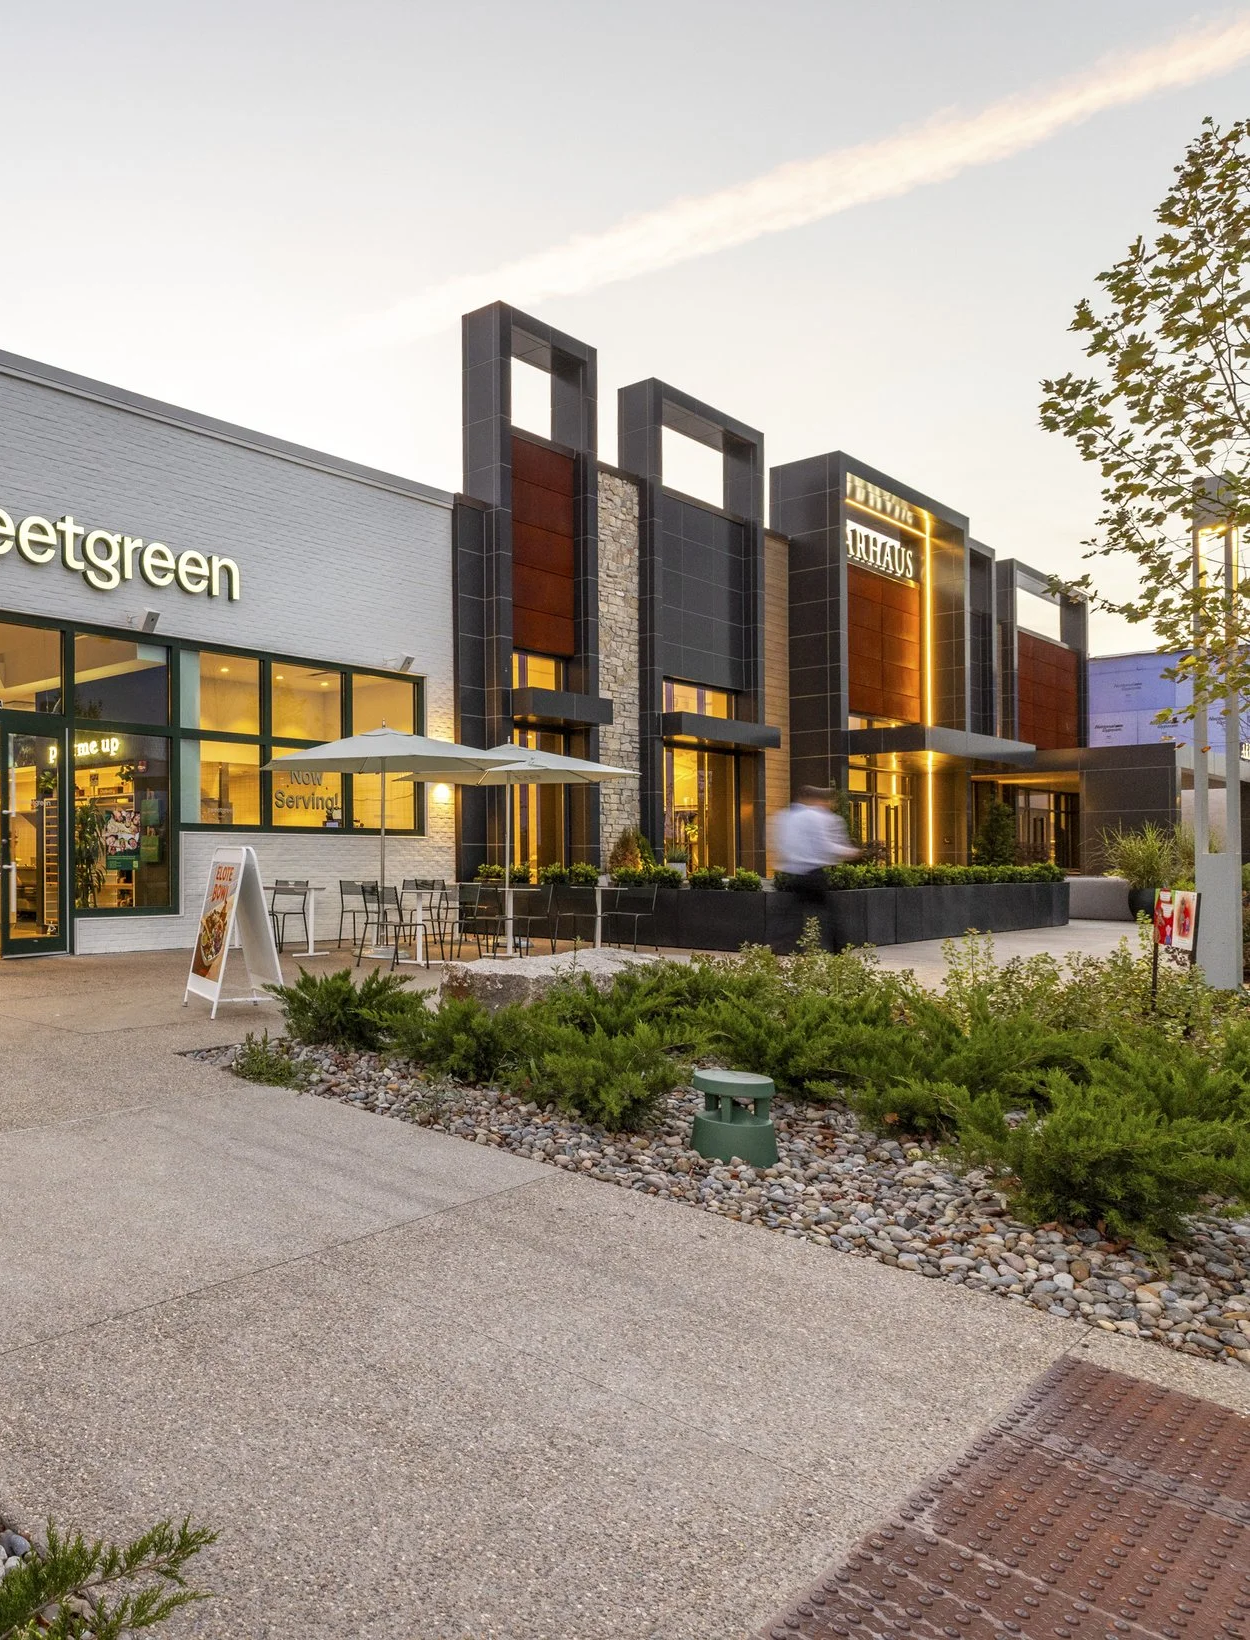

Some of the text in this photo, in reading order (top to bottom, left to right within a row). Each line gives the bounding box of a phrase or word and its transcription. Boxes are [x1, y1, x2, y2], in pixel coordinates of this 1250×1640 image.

[101, 737, 119, 756] up
[290, 769, 323, 786] Now
[274, 789, 339, 814] Serving!
